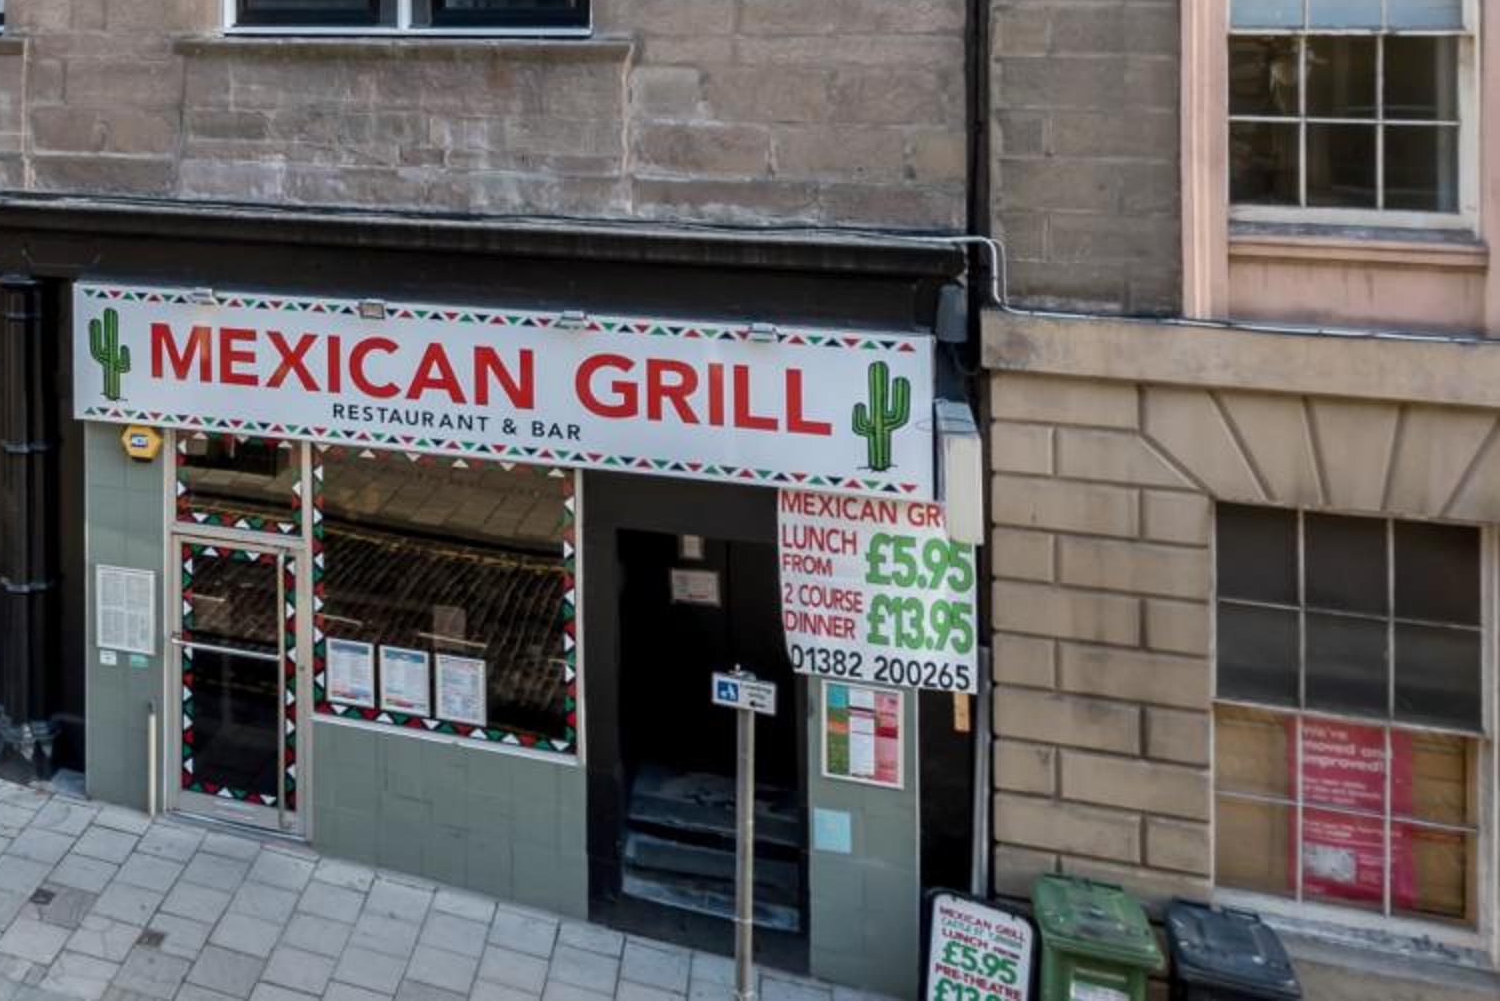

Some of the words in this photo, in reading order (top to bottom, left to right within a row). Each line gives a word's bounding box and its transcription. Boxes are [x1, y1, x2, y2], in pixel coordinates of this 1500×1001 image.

[150, 321, 534, 410] MEXICAN
[575, 353, 833, 436] GRILL
[333, 403, 490, 432] RESTAURANT
[502, 417, 517, 435] &
[531, 420, 581, 440] BAR
[781, 490, 898, 525] MEXICAN
[781, 523, 858, 555] LUNCH
[782, 553, 833, 577] FROM
[865, 532, 974, 593] £5.95
[784, 582, 793, 604] 2
[799, 584, 864, 613] COURSE
[784, 610, 856, 639] DINNER
[867, 593, 974, 654] £13.95
[791, 644, 863, 677] 01382
[874, 655, 970, 690] 200265
[940, 906, 993, 930] MEXICAN
[995, 924, 1025, 942] GRILL
[942, 927, 989, 950] LUNCH
[941, 940, 1018, 985] £5.95
